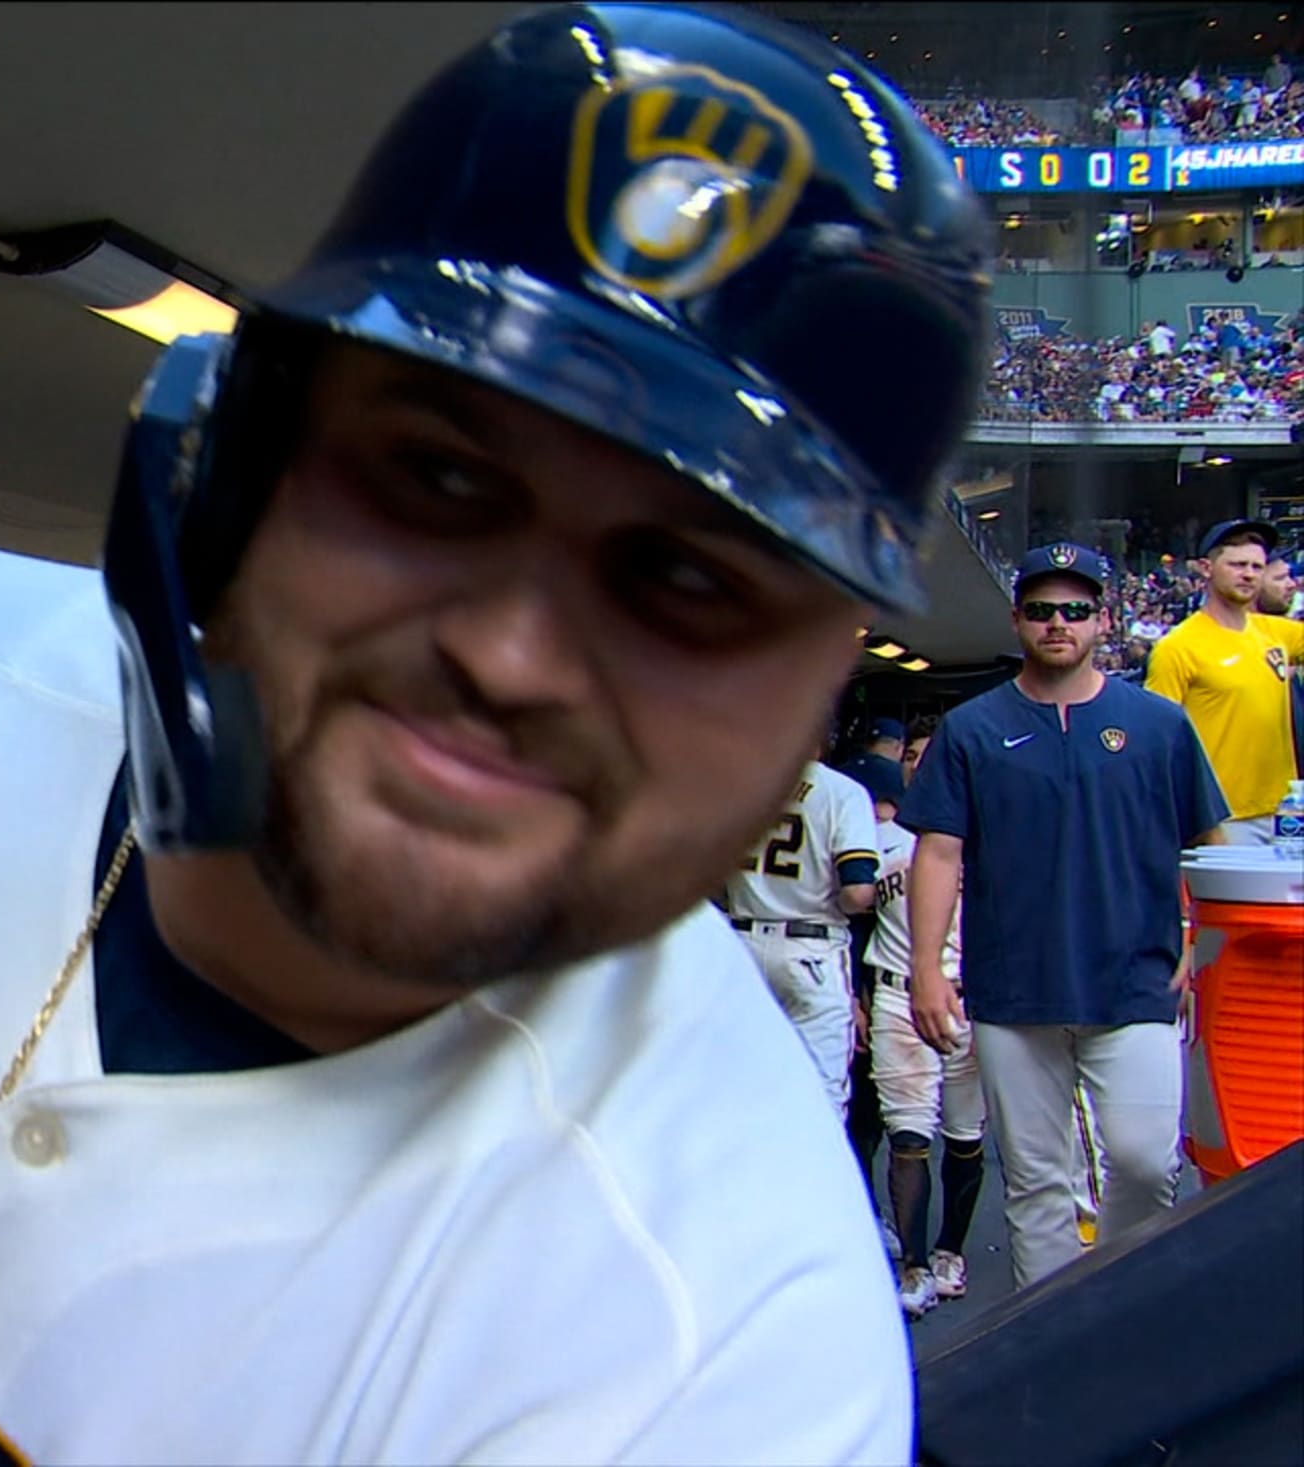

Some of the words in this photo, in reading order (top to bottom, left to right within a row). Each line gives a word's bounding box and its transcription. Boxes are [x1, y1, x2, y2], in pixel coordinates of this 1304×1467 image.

[999, 152, 1023, 187] S
[1128, 153, 1151, 186] 2
[999, 311, 1032, 325] 2011
[874, 870, 908, 908] BR
